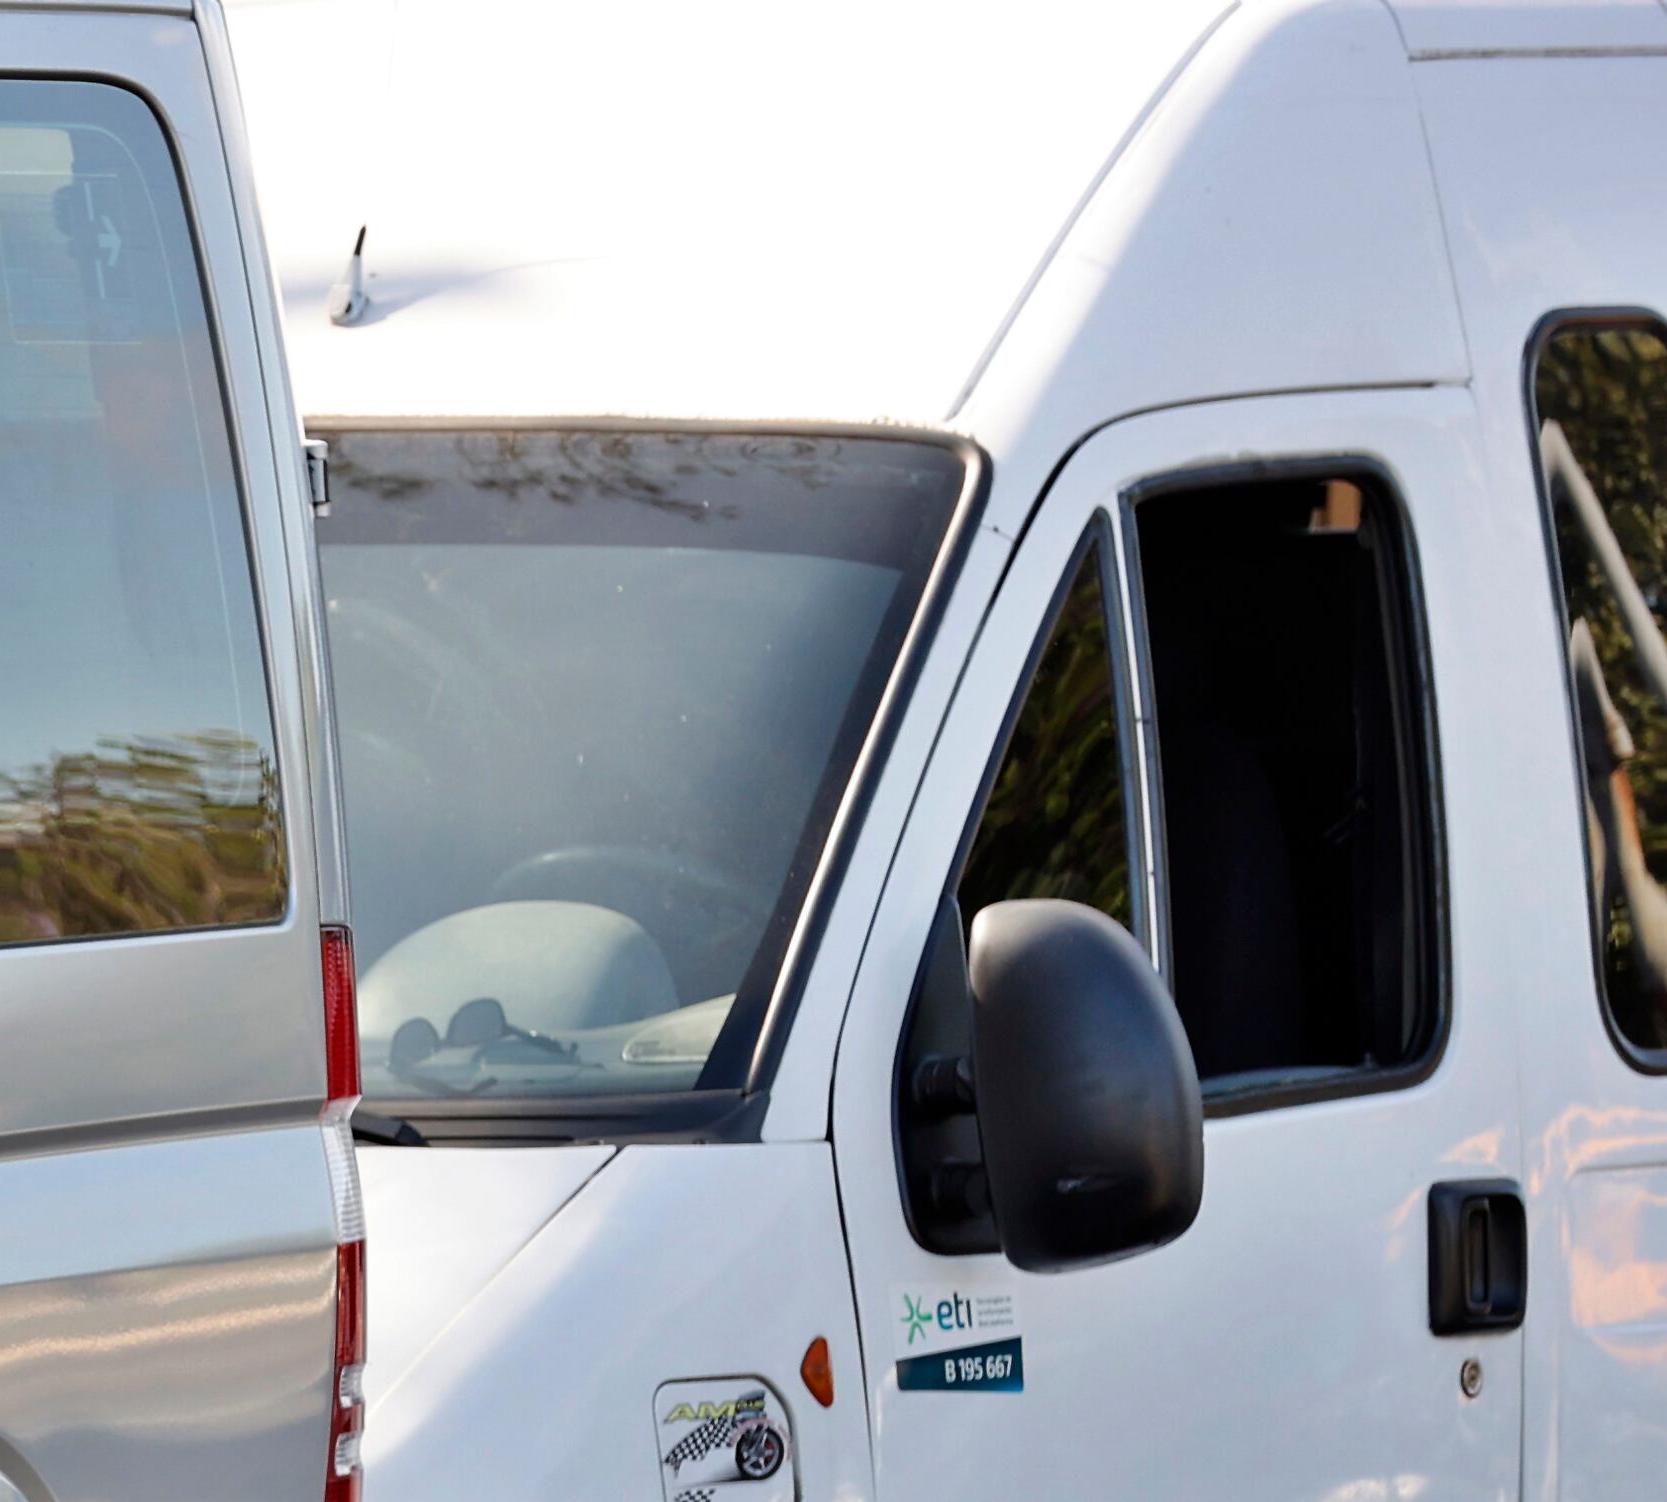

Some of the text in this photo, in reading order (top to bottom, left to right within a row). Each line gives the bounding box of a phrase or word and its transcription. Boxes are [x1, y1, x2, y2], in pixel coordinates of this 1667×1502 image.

[944, 1354, 1012, 1383] B 195 667
[663, 1400, 736, 1423] AM
